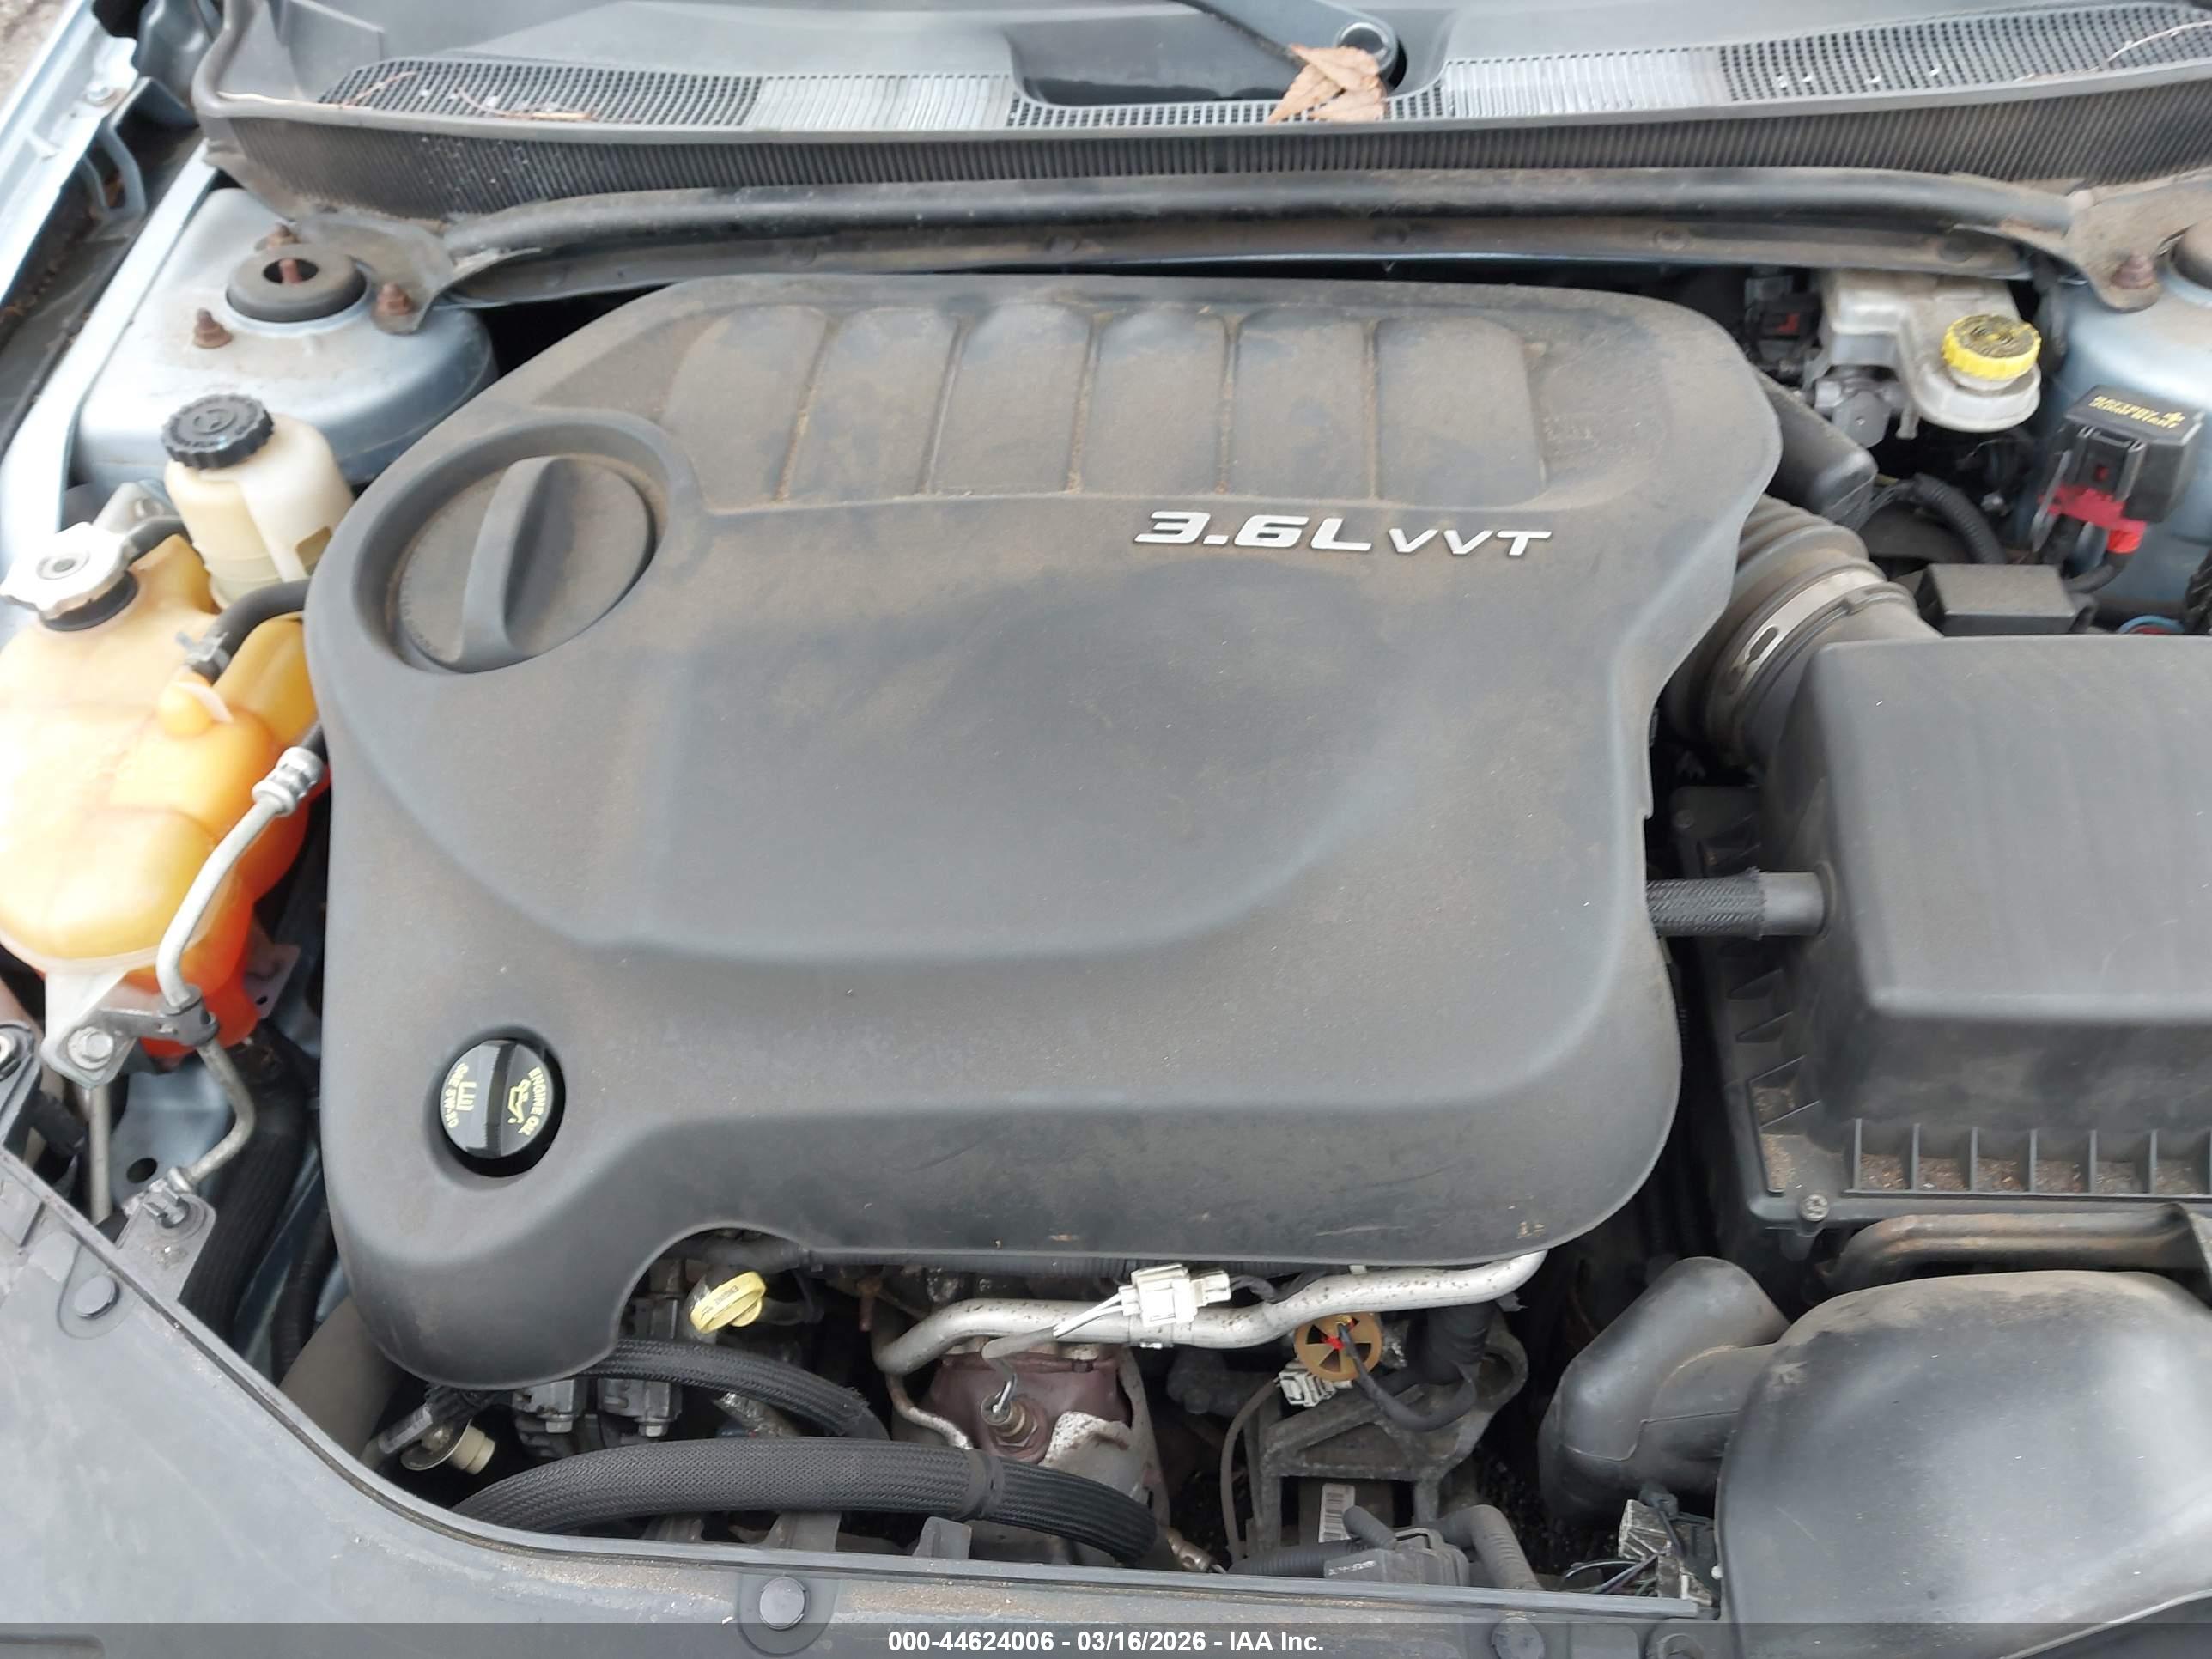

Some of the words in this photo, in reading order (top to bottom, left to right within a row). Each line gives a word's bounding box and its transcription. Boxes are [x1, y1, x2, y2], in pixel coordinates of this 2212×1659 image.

[1134, 511, 1372, 551] 3.6L
[1388, 527, 1553, 556] VVT
[528, 1066, 546, 1115] ENGINE
[518, 1115, 539, 1135] OIL
